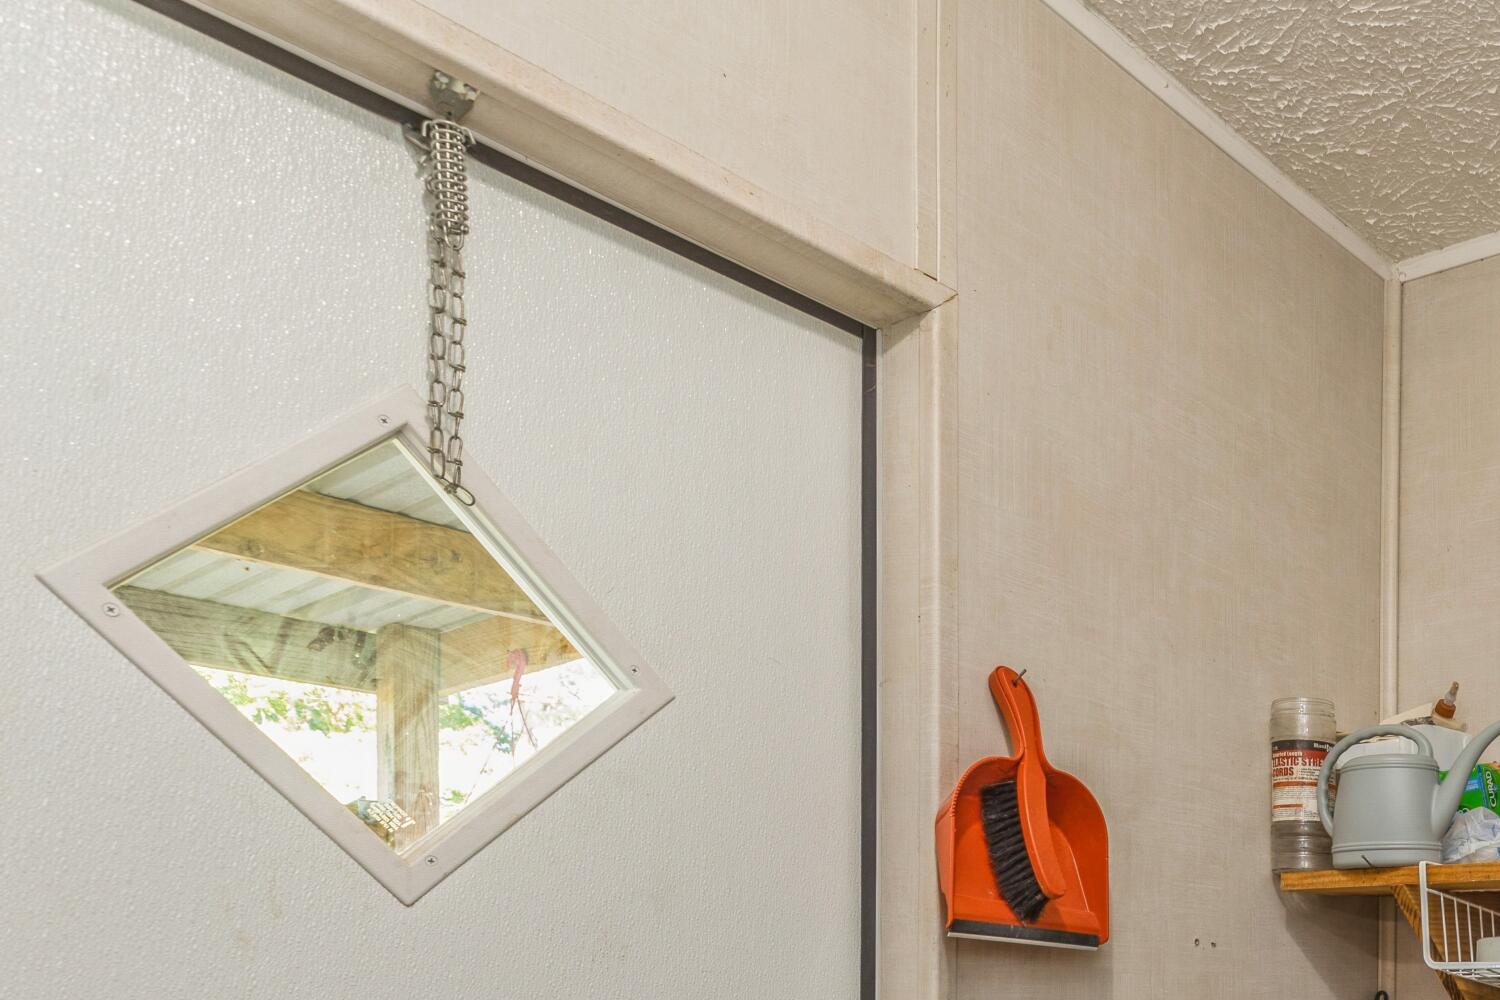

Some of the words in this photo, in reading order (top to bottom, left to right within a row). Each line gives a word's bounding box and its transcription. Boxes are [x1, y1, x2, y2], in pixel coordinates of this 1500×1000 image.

[1301, 758, 1322, 767] STRE
[1273, 767, 1293, 777] CORDS
[1486, 771, 1496, 807] CURAD
